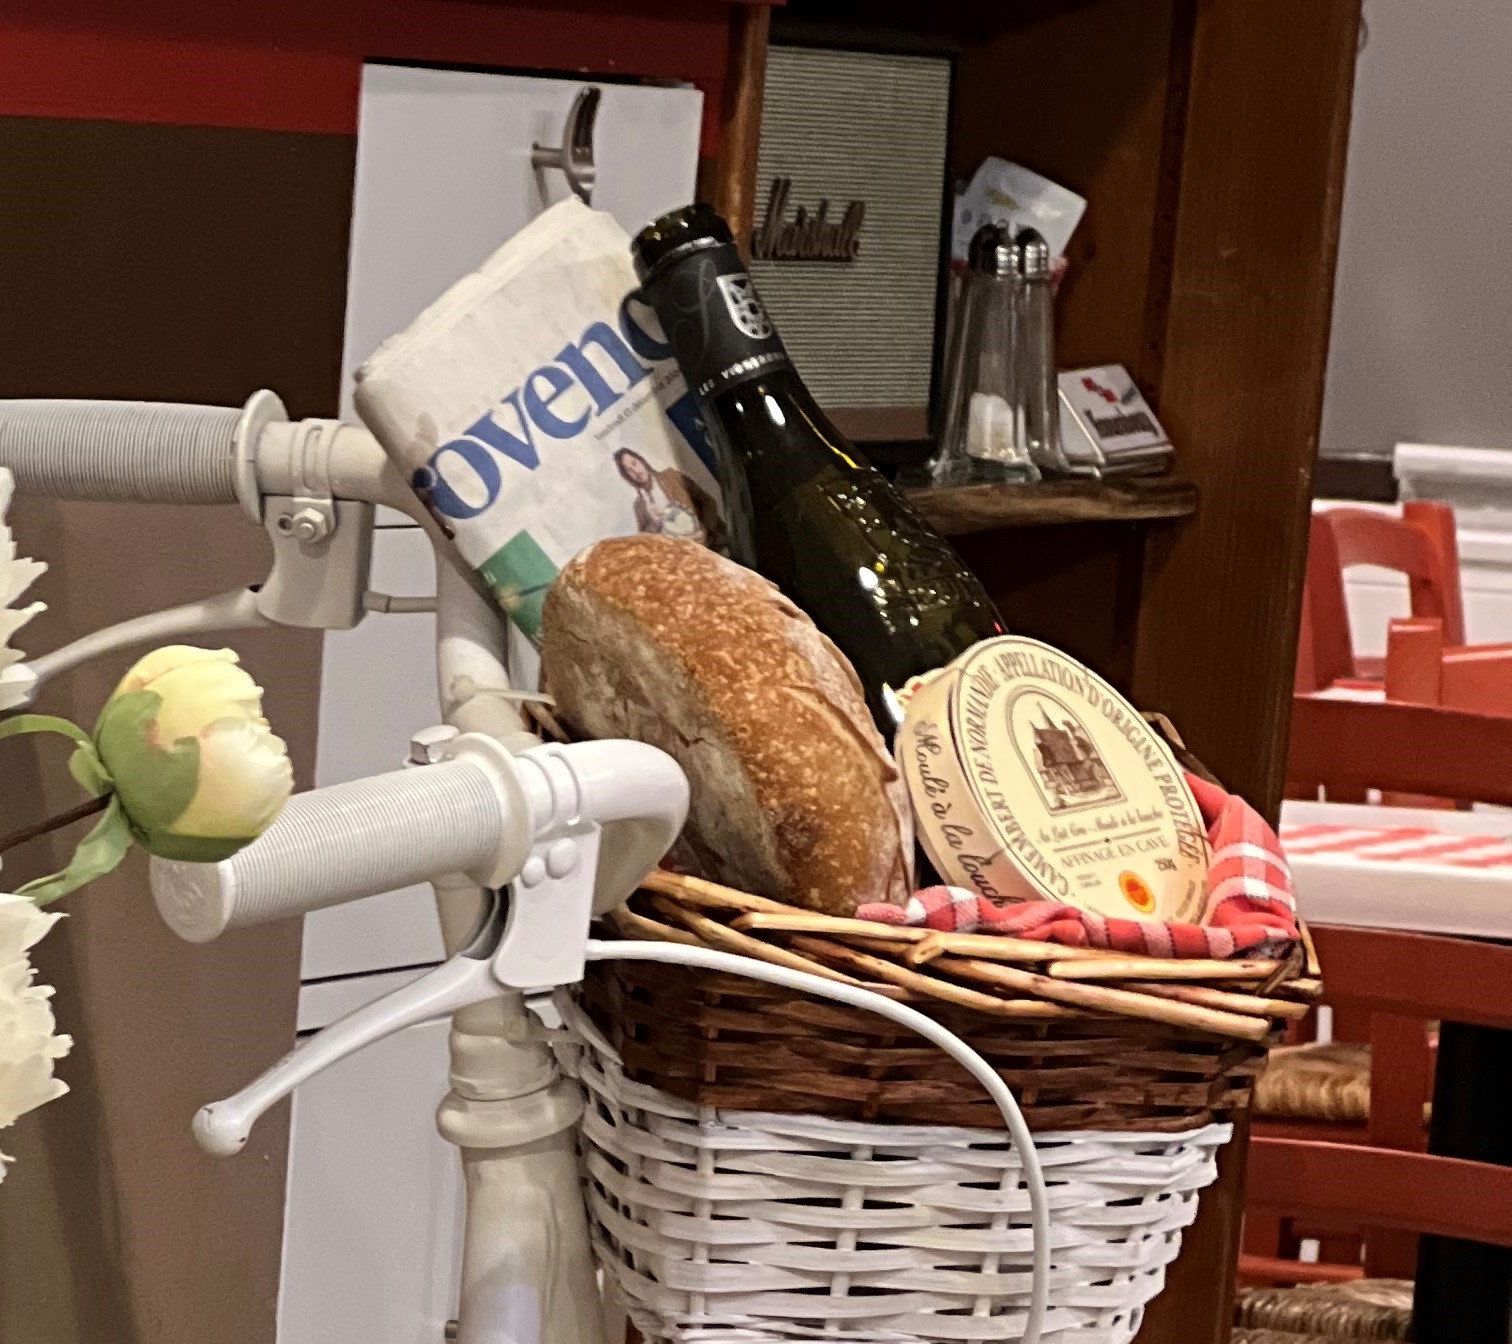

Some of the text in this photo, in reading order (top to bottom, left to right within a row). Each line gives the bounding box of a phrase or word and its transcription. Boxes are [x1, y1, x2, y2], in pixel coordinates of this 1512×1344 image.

[749, 177, 865, 262] Marshall
[413, 289, 676, 519] ovenc
[966, 664, 1001, 760] NORMANDE
[992, 651, 1085, 698] APPELLATION
[973, 757, 999, 784] DE
[1087, 684, 1165, 773] D'ORIGINE
[931, 802, 953, 820] à
[941, 823, 975, 850] la
[985, 787, 1070, 896] CAMEMBERT
